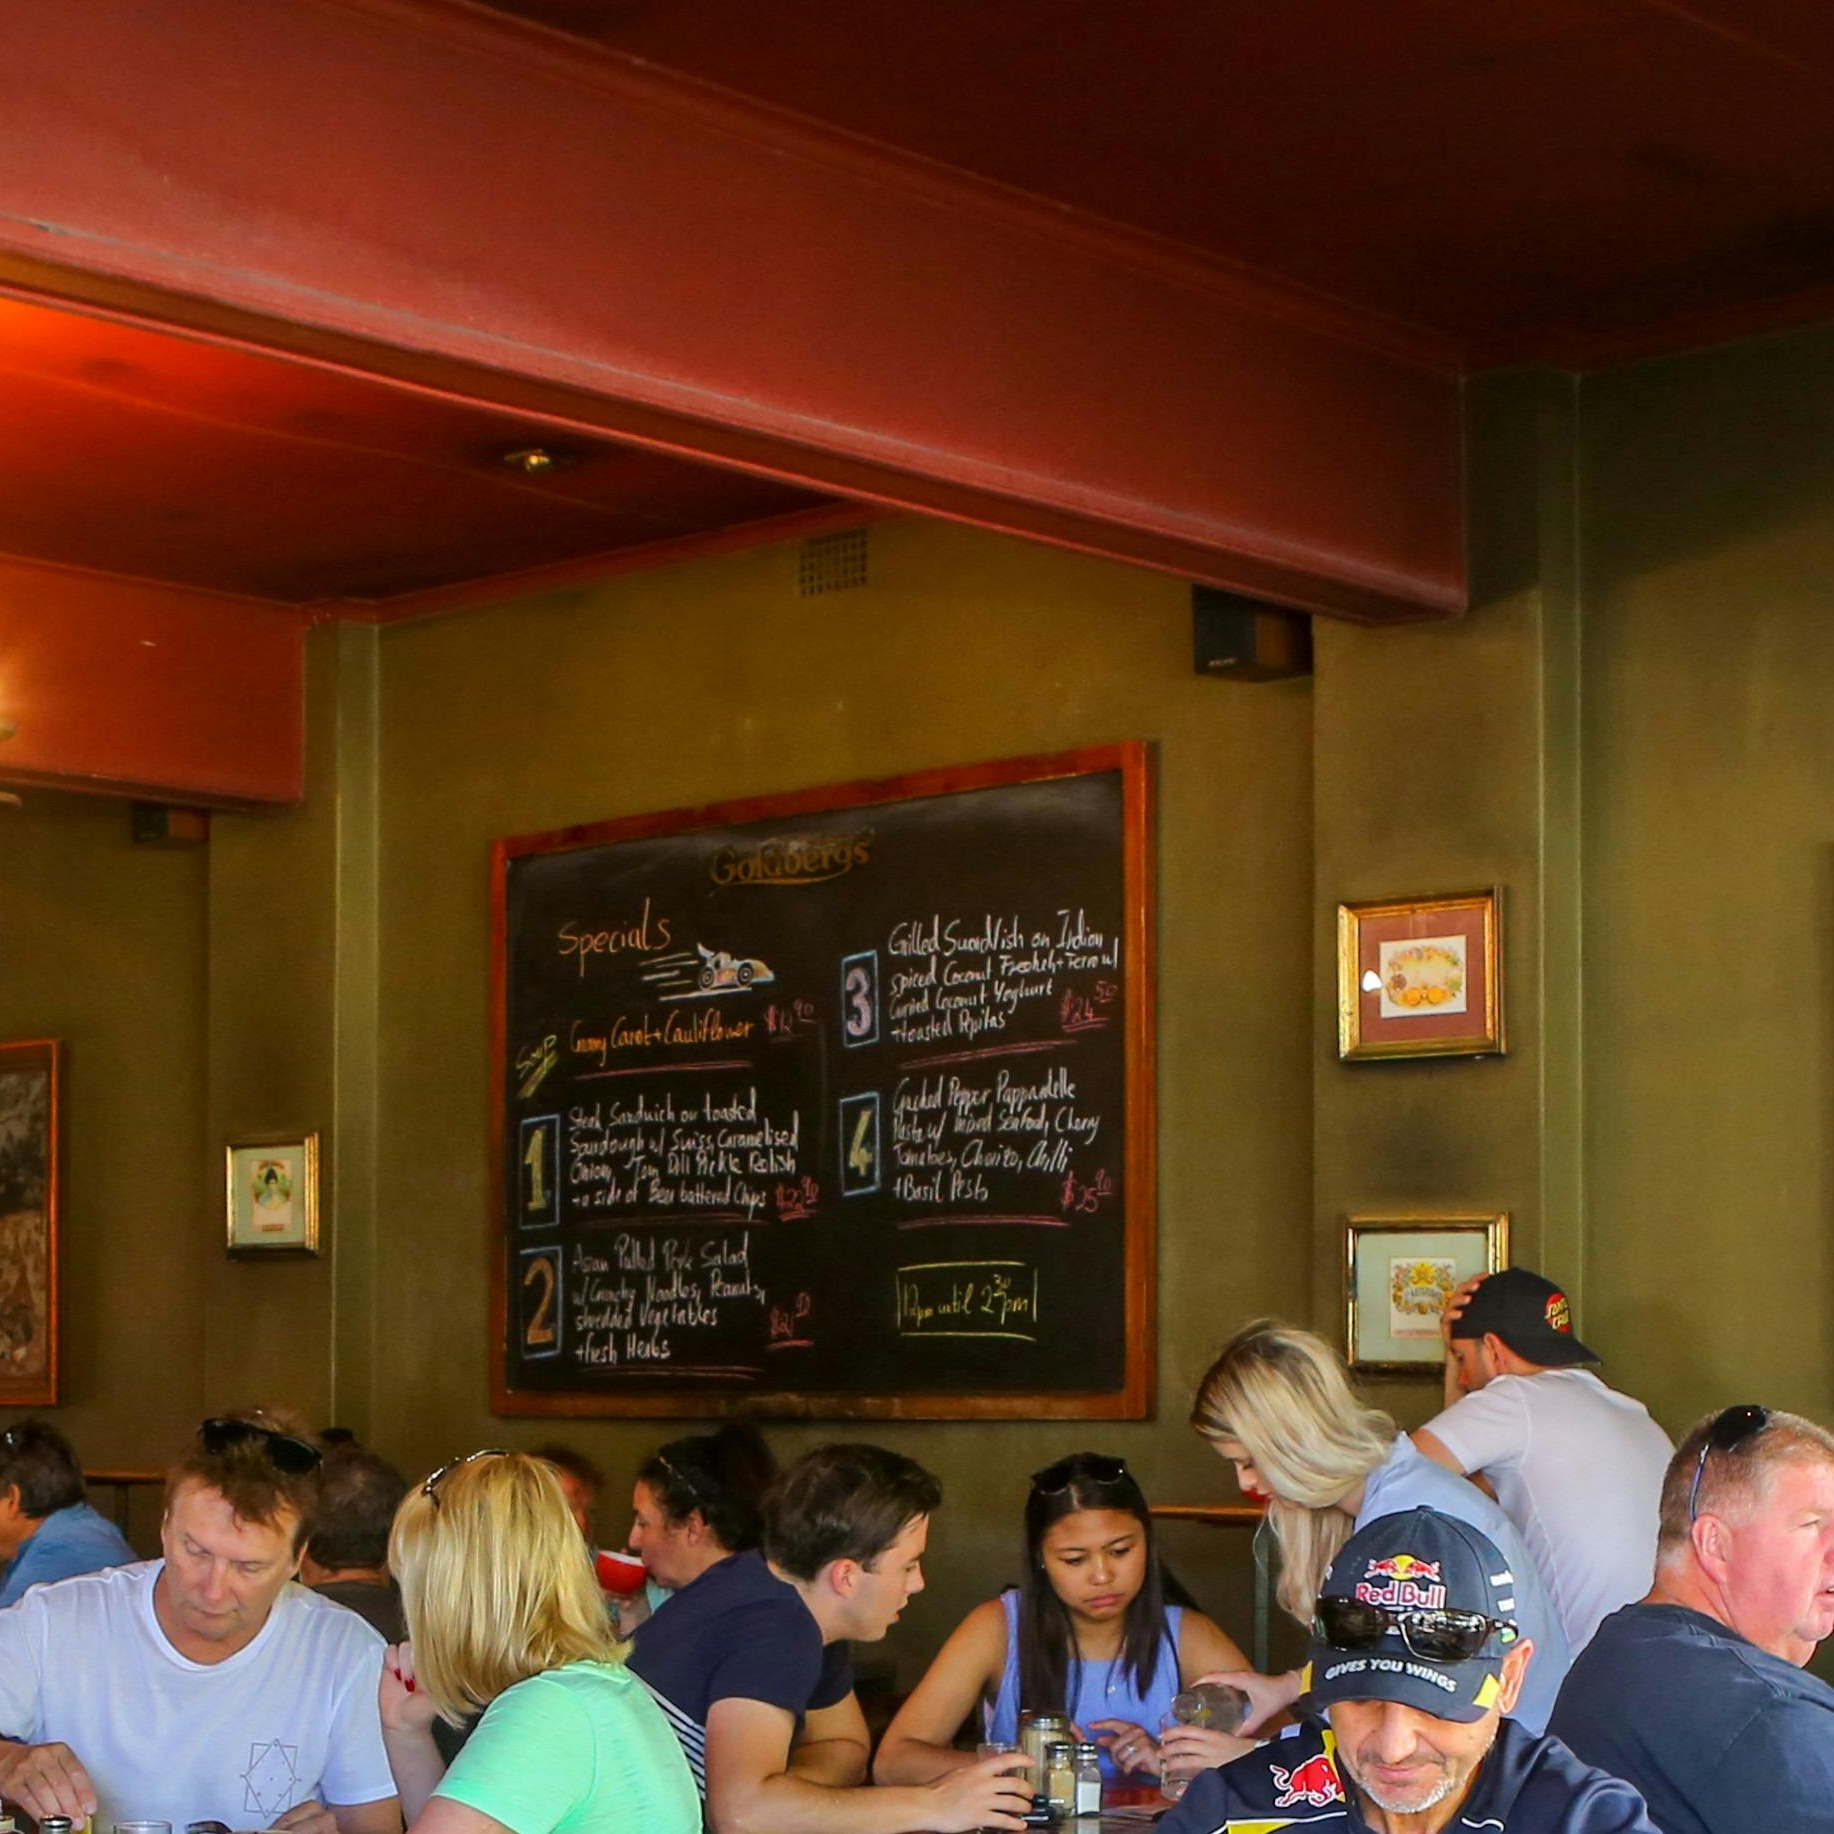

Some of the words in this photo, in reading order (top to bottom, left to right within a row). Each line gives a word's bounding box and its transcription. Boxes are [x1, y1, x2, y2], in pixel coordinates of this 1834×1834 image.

[558, 896, 671, 977] Specials
[846, 968, 871, 1036] 3
[524, 1127, 547, 1210] 1
[849, 1110, 872, 1176] 4
[524, 1257, 555, 1344] 2
[1356, 1581, 1400, 1606] Red
[1400, 1582, 1447, 1609] Bull
[1324, 1659, 1368, 1681] GIVES
[1368, 1658, 1404, 1673] YOU
[1404, 1661, 1458, 1693] WINGS
